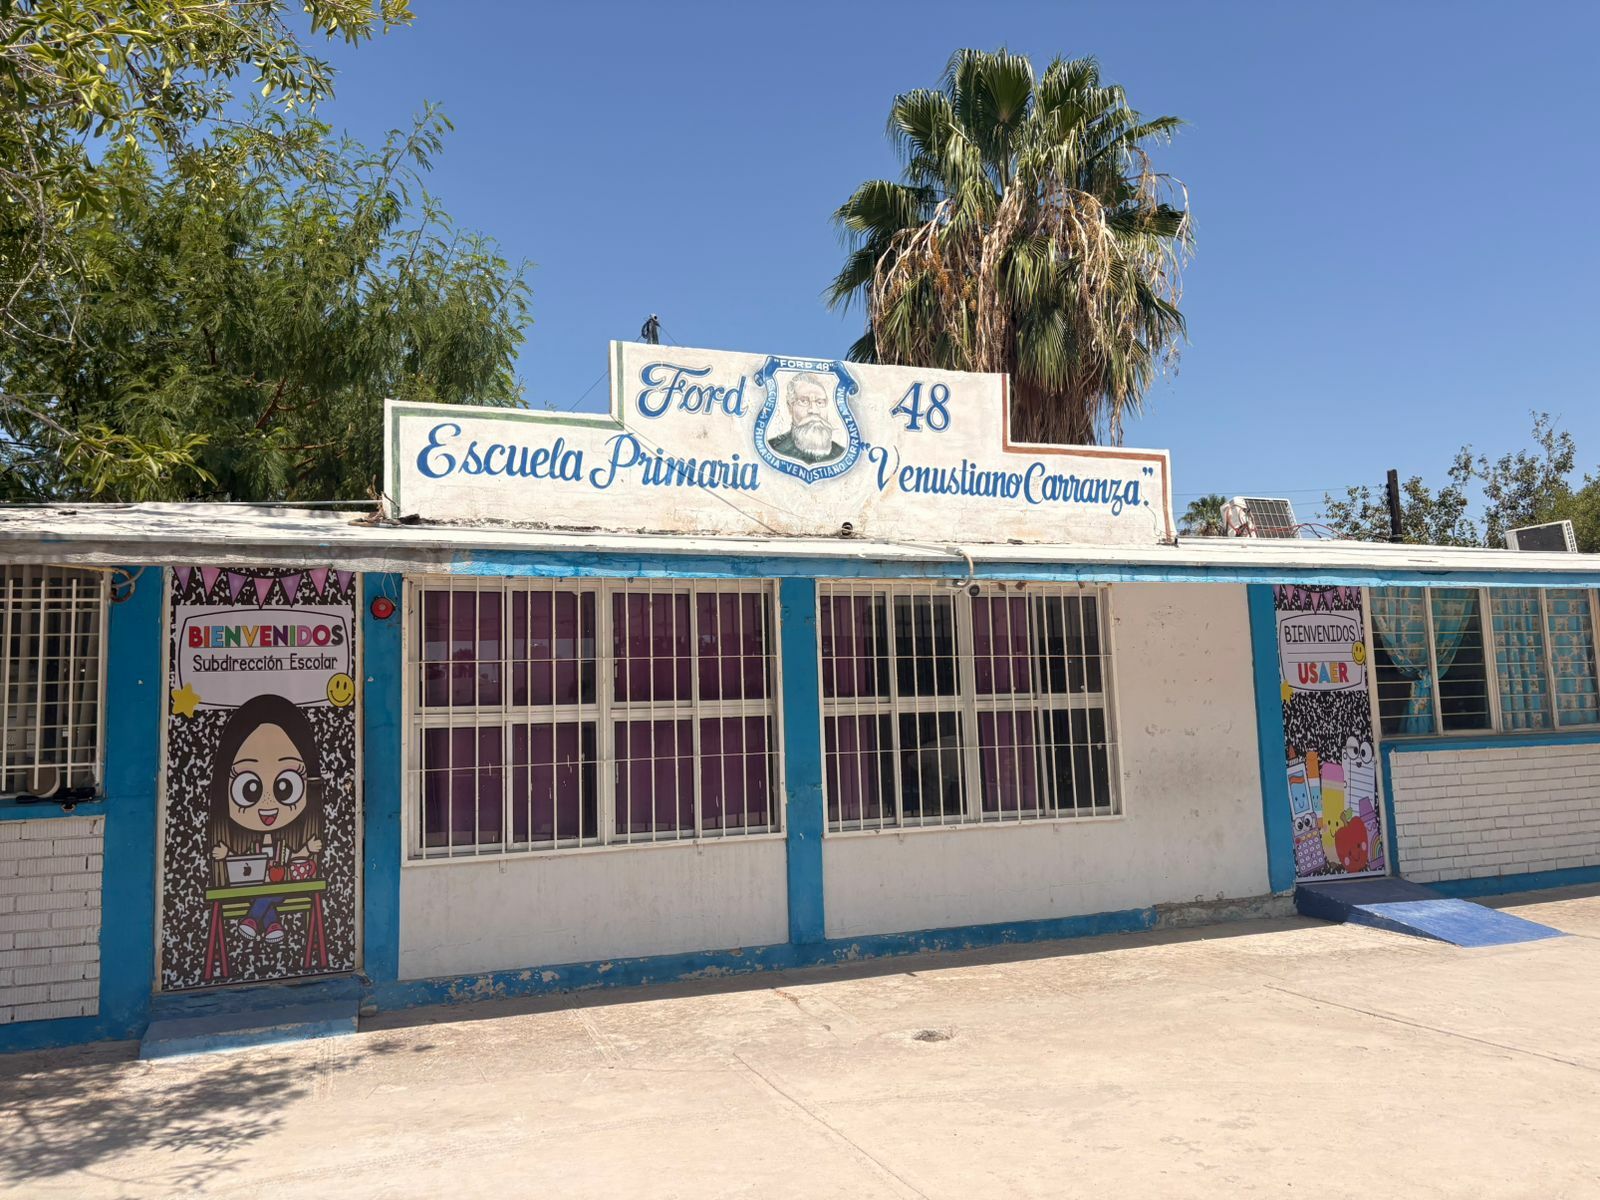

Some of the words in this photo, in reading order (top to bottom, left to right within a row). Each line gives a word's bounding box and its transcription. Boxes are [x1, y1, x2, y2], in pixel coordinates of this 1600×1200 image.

[637, 362, 747, 419] Ford
[892, 381, 951, 432] 48
[760, 378, 777, 420] ESCUELA
[416, 423, 584, 481] Escuela
[589, 432, 761, 491] Primaria
[755, 420, 781, 469] PRIMARIA
[188, 624, 344, 648] BIENVENIDOS
[1284, 625, 1355, 643] BIENVENIDOS
[192, 654, 283, 672] Subdirección
[289, 653, 338, 671] Escolar
[1297, 662, 1349, 685] USAER
